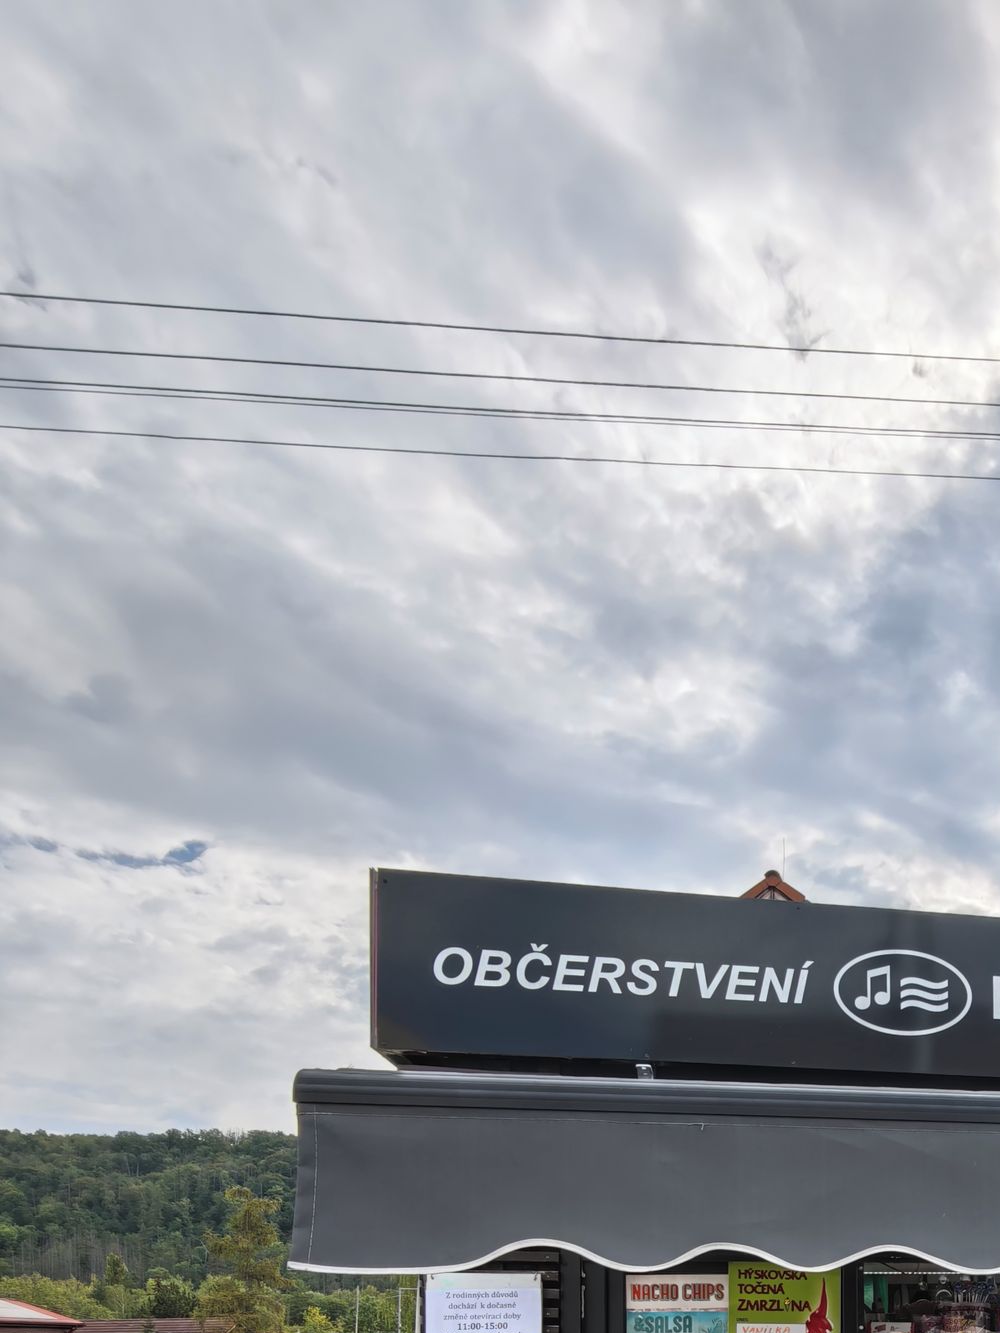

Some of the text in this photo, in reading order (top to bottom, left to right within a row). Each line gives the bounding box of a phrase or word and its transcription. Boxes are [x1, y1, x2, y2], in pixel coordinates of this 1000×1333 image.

[433, 943, 815, 1004] OBČERSTVENÍ
[631, 1283, 725, 1301] NACHO CHIPS
[737, 1282, 785, 1295] TOČENÁ
[452, 1292, 490, 1300] rodinných
[491, 1291, 518, 1299] důvodů
[448, 1302, 477, 1310] dochází
[469, 1312, 501, 1320] otevírací
[503, 1312, 522, 1321] doby
[457, 1322, 508, 1330] 11:00-15:00
